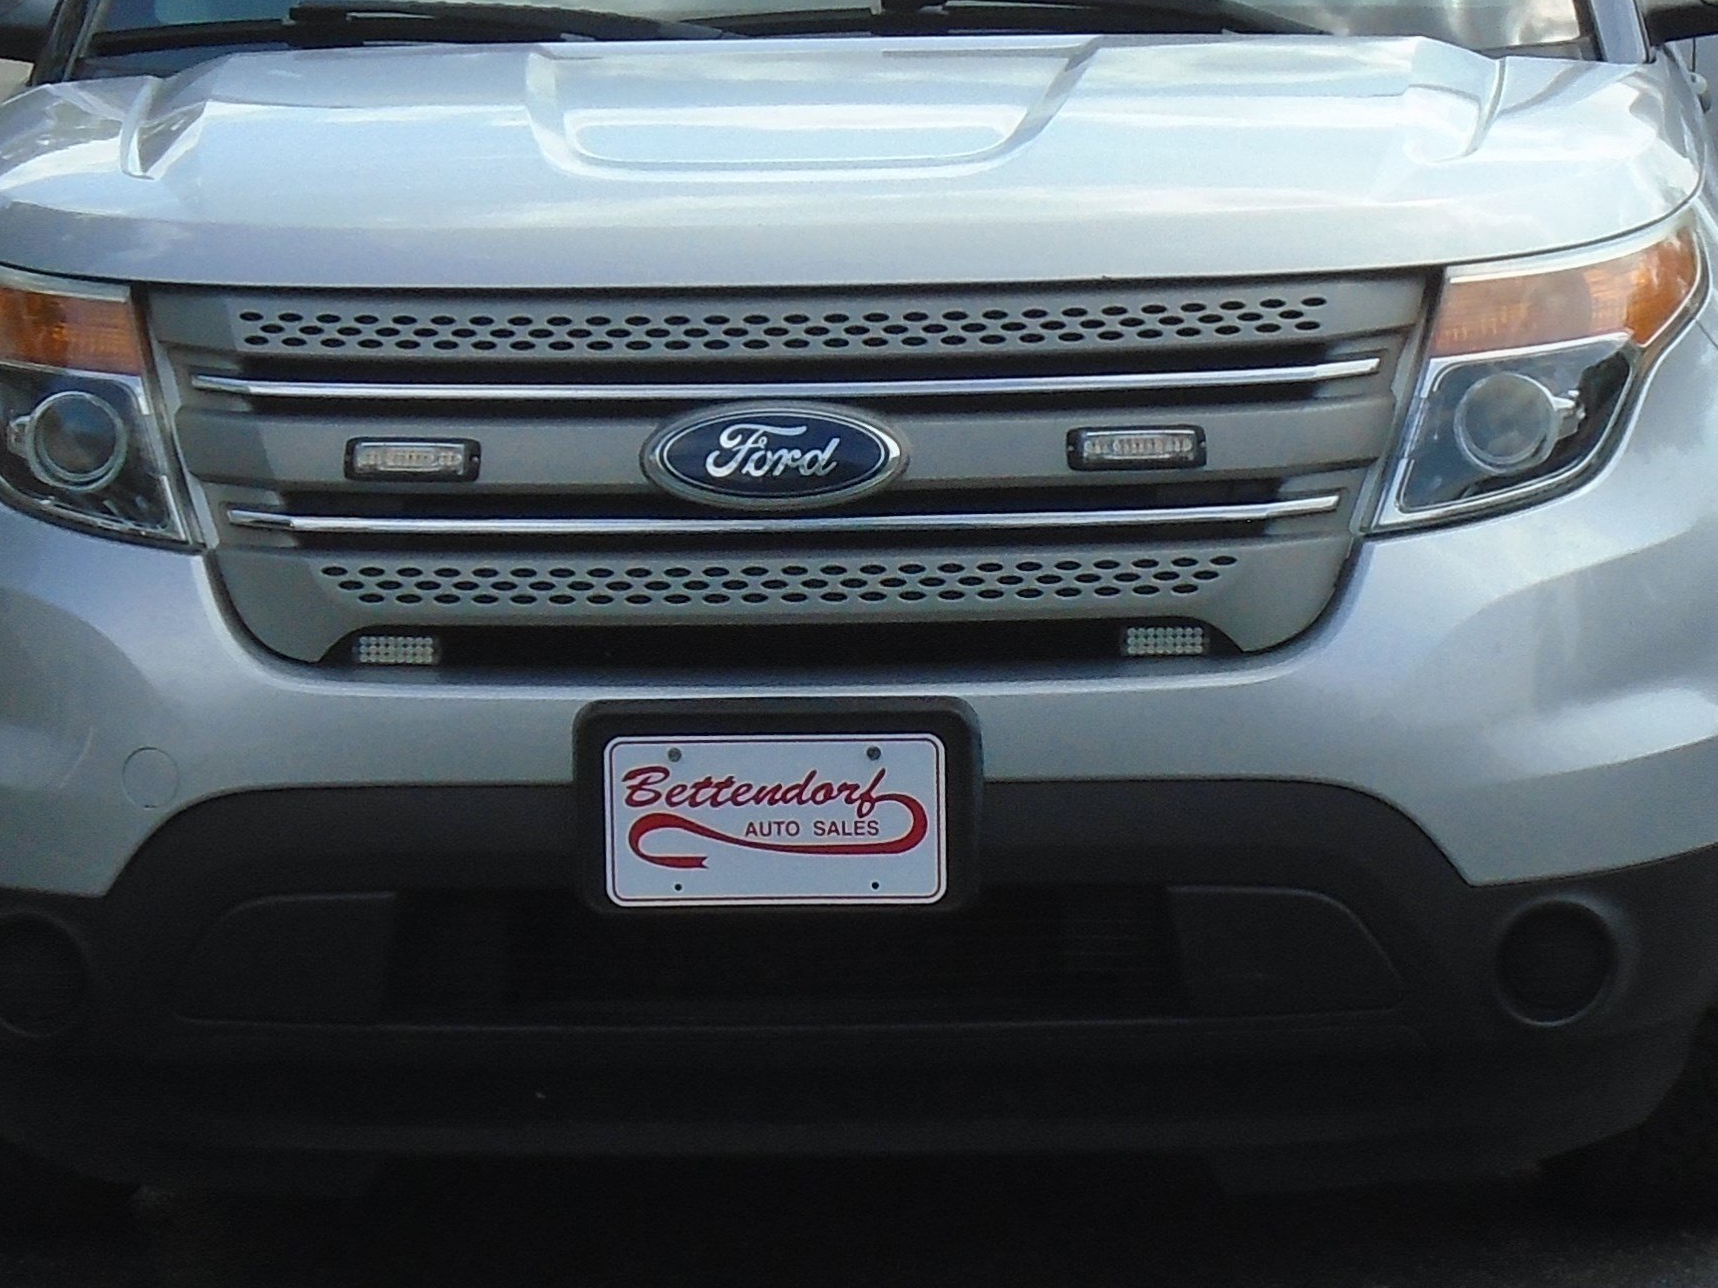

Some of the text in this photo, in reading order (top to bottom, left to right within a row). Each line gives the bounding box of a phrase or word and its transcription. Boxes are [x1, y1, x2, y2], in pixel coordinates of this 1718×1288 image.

[705, 423, 840, 478] Ford
[621, 765, 887, 819] Bettendorf
[744, 820, 880, 838] AUTO SALES
